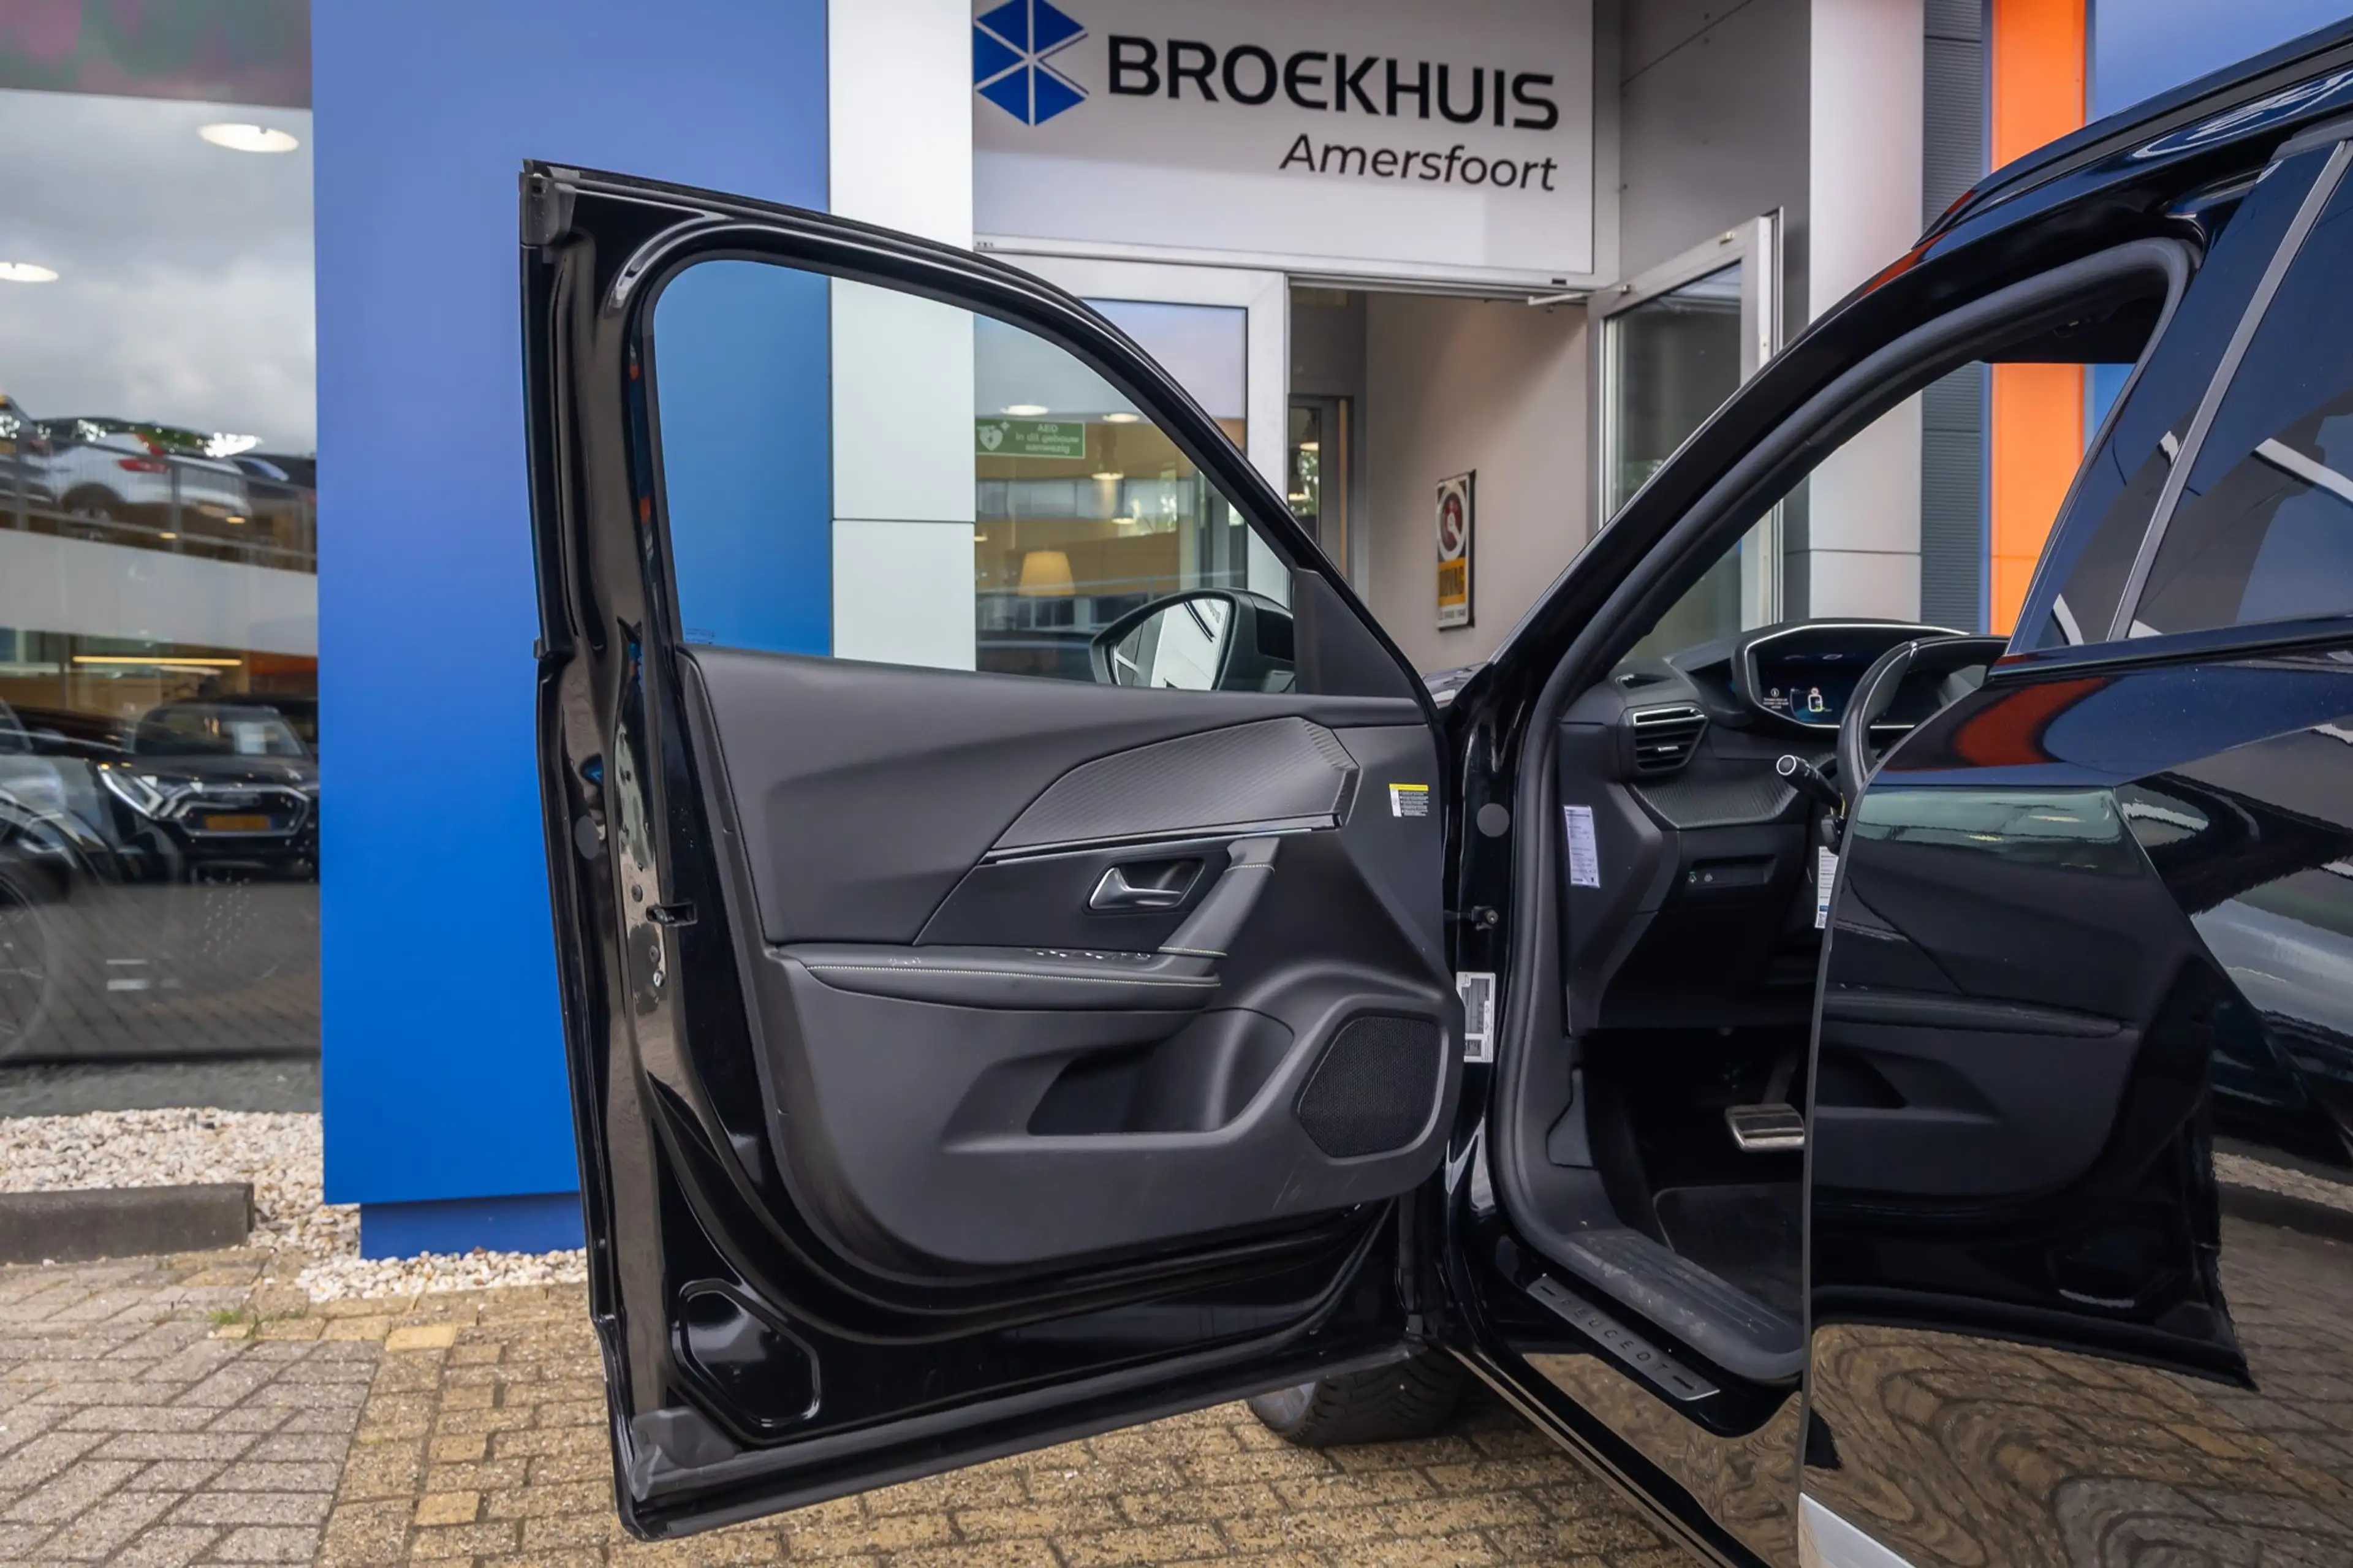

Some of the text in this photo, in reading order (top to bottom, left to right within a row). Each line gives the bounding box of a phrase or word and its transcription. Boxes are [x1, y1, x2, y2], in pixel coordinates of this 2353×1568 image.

[1108, 35, 1559, 131] BROEKHUIS
[1279, 134, 1558, 191] Amersfoort
[1037, 423, 1059, 433] AED
[1026, 432, 1040, 442] dit
[1041, 434, 1080, 444] gebouw
[1025, 444, 1070, 454] aanwezig
